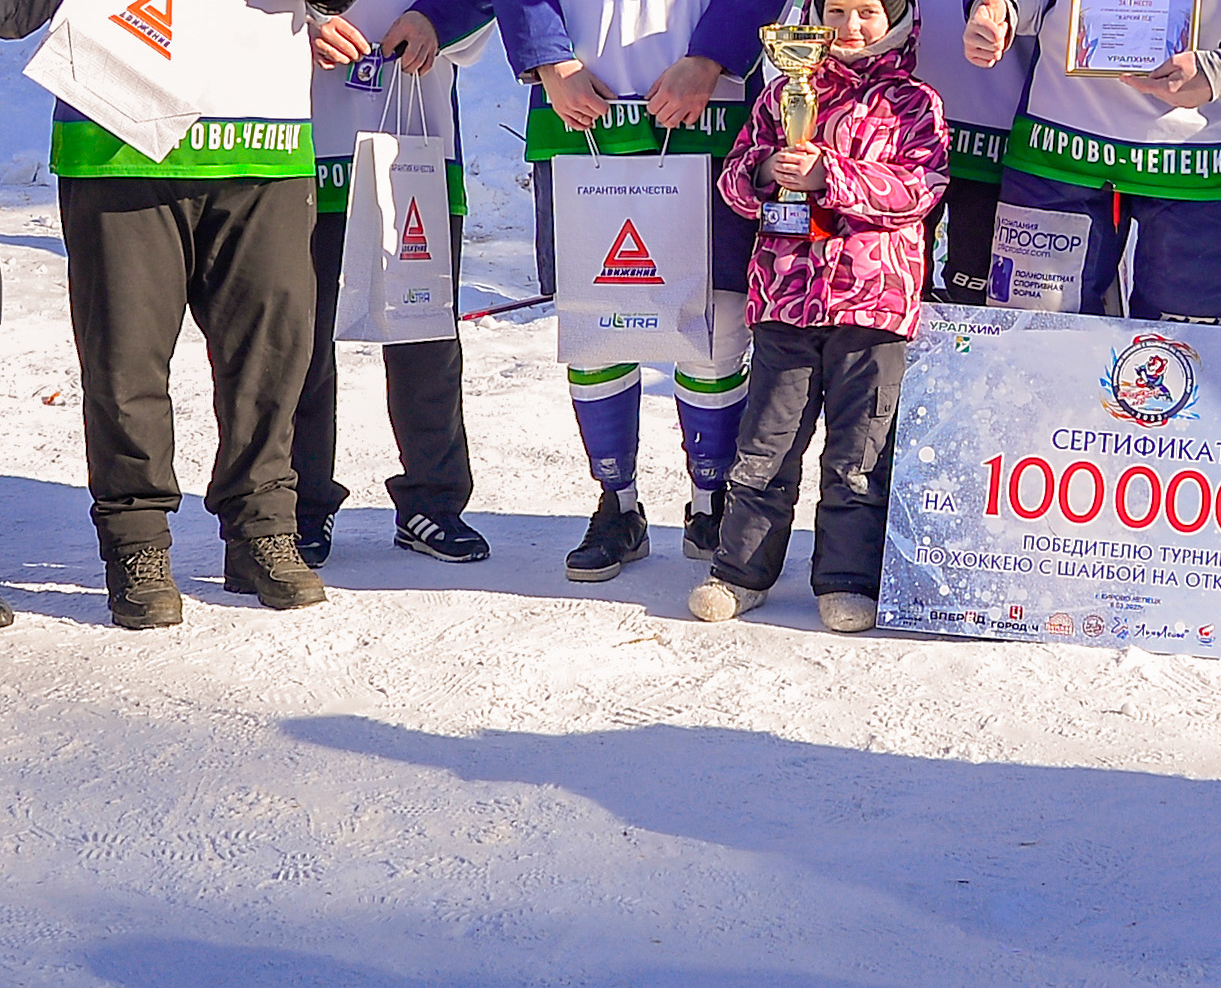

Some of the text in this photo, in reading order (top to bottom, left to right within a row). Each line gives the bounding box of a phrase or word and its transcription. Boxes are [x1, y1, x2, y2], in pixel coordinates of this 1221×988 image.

[1107, 55, 1156, 63] УРАЛХИМ
[577, 186, 679, 196] ГАРАНТИЯ КАЧЕСТВА
[999, 225, 1082, 253] ПРОСТОР
[600, 268, 657, 277] ДВИЖЕНИЕ
[1012, 288, 1042, 299] ФОРМА
[599, 312, 659, 329] ULTRA
[929, 320, 1001, 336] УРАЛХИМ
[925, 492, 956, 513] НА
[982, 454, 1106, 524] 100
[1023, 535, 1153, 560] ПОБЕДИТЕЛЮ
[916, 548, 944, 565] ПО
[951, 551, 1034, 573] ХОККЕЮ
[1039, 559, 1052, 575] С
[1057, 561, 1146, 584] ШАЙБОЙ
[1152, 572, 1179, 588] НА
[991, 620, 1028, 632] ГОРОД
